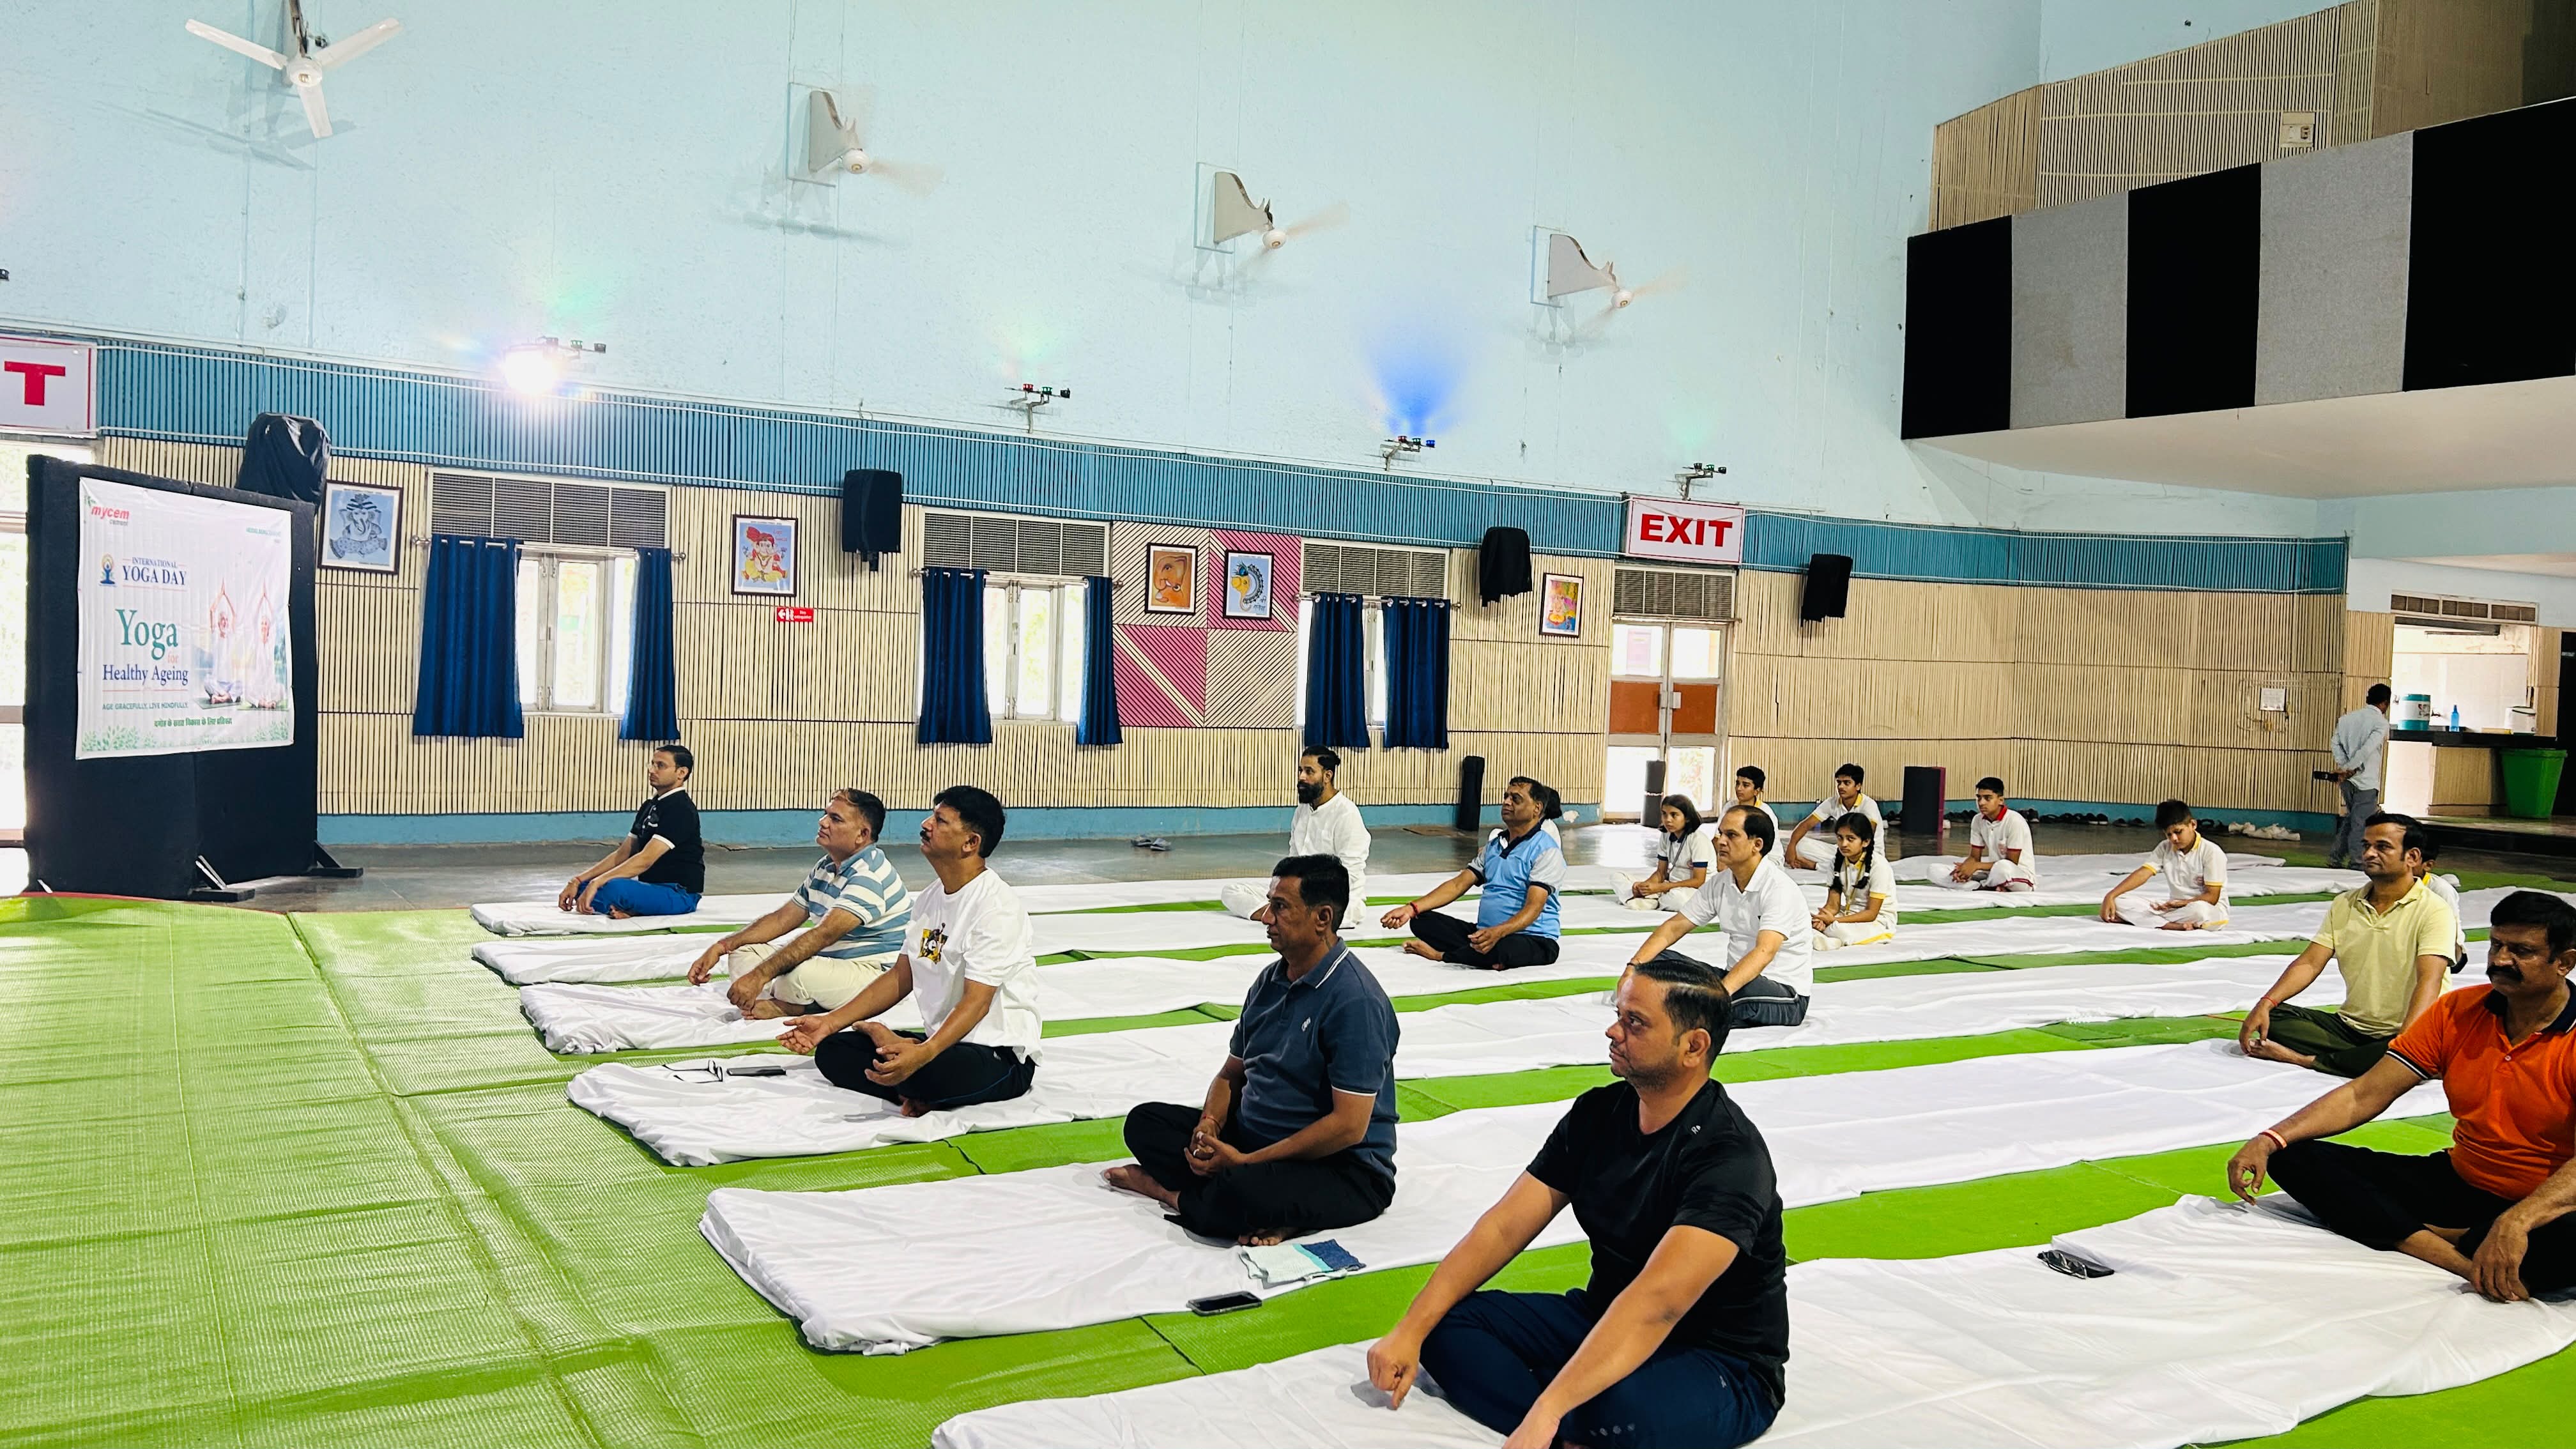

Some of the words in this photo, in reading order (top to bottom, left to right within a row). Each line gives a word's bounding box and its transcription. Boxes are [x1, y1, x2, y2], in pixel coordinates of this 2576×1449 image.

[91, 507, 130, 519] mycem
[1640, 513, 1733, 547] EXIT
[132, 556, 178, 568] INTERNATIONAL
[123, 565, 158, 583] YOGA
[162, 569, 187, 585] DAY
[115, 609, 178, 661] Yoga
[167, 651, 179, 664] for
[102, 664, 149, 685] Healthy
[151, 665, 189, 686] Ageing
